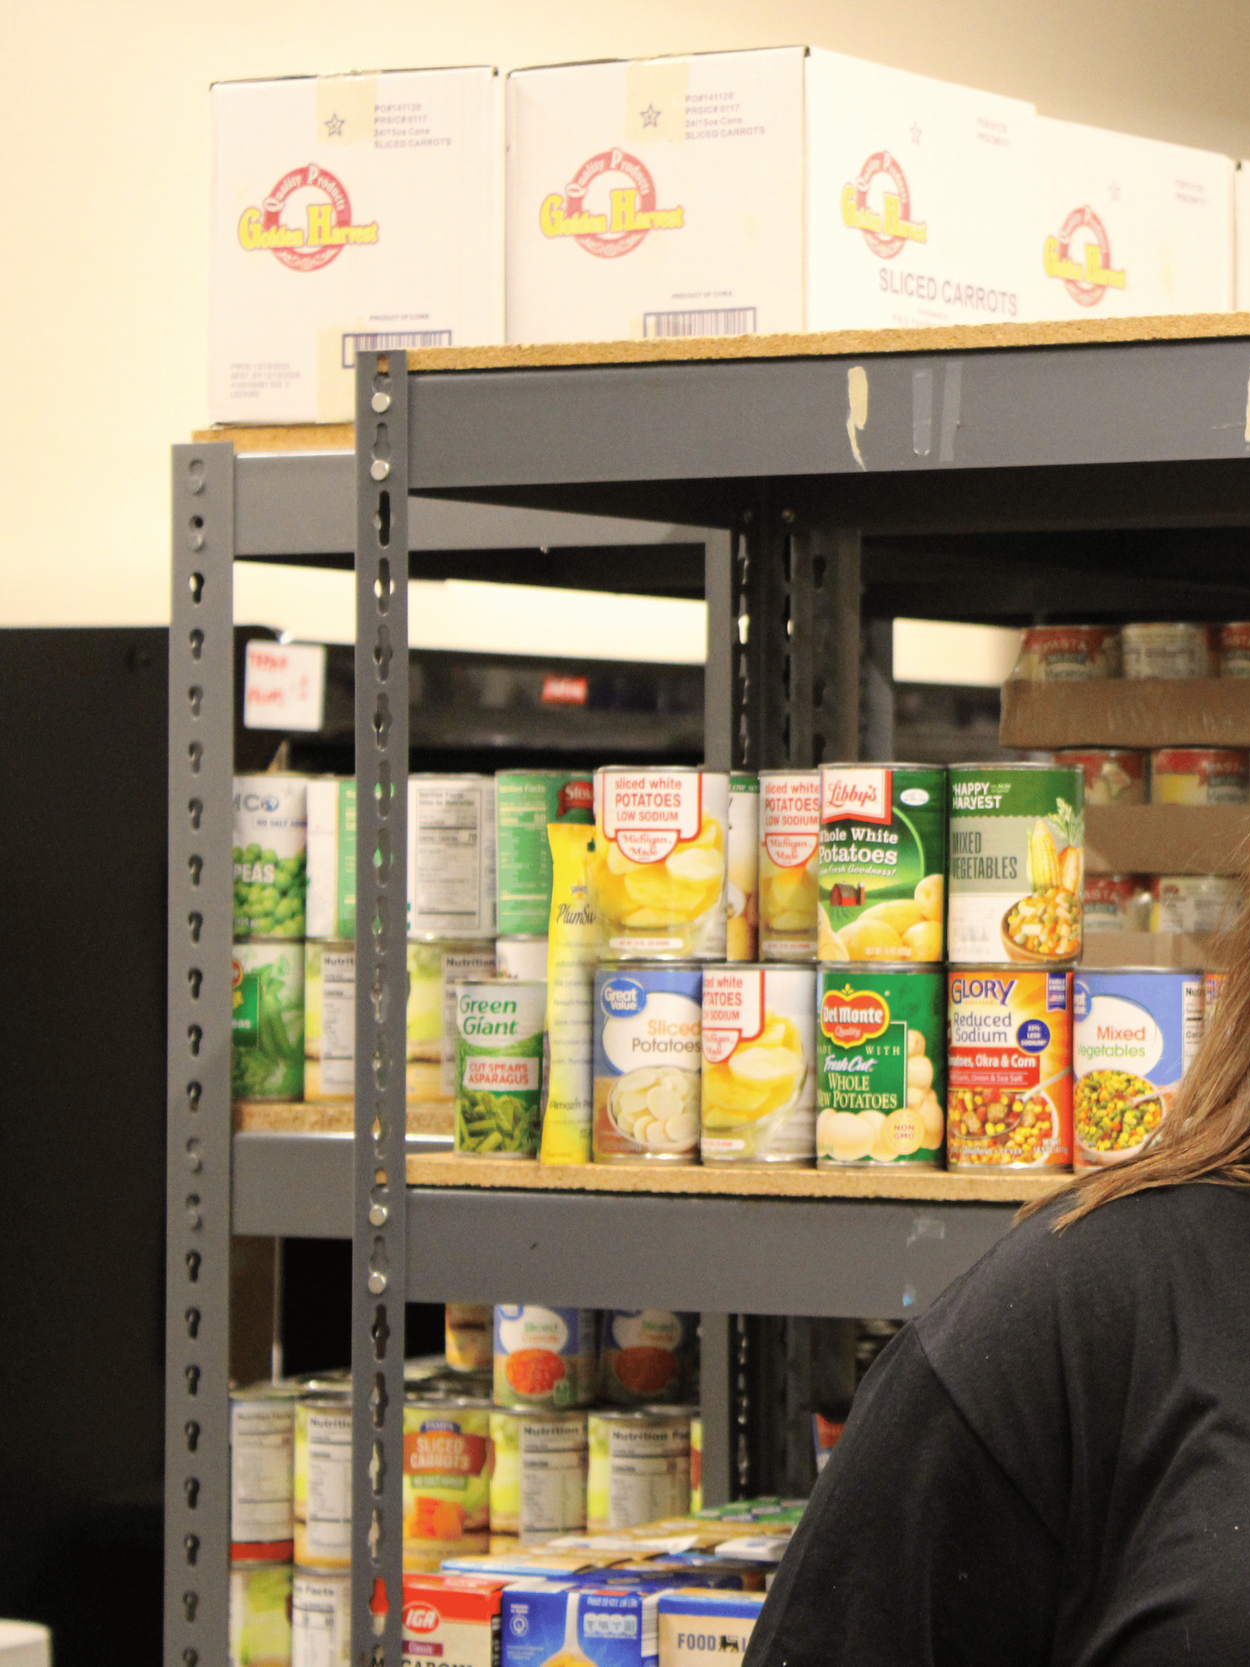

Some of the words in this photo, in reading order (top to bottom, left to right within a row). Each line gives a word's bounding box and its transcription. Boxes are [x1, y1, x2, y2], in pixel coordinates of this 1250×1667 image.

[720, 126, 765, 138] CARROTS
[408, 137, 451, 148] CARROTS
[540, 193, 608, 239] Golden
[609, 187, 685, 232] Harvest
[238, 207, 304, 251] Golden
[306, 203, 379, 247] Harvest
[878, 267, 938, 301] SLICED
[941, 279, 1018, 317] CARROTS
[615, 778, 645, 790] sliced
[649, 778, 682, 790] white
[765, 782, 787, 794] sliced
[790, 782, 820, 794] white
[953, 782, 990, 796] HAPPY
[615, 793, 682, 808] POTATOES
[827, 780, 878, 808] Libby's
[765, 798, 820, 812] POTATOES
[952, 795, 1003, 810] HARVEST
[617, 811, 636, 822] LOW
[638, 811, 678, 822] SODIUM
[766, 815, 779, 826] LOW
[782, 815, 818, 826] SODIUM
[622, 834, 668, 848] Michigan
[850, 827, 898, 845] White
[952, 831, 982, 855] MIXED
[629, 846, 658, 857] Made
[819, 843, 898, 866] Potatoes
[233, 863, 274, 883] PEAS
[952, 856, 1018, 880] VEGETABLES
[324, 957, 354, 966] Nutrit
[716, 977, 743, 989] white
[605, 988, 638, 1002] Great
[703, 992, 742, 1007] TATOES
[952, 979, 1019, 1007] GLORY
[459, 995, 517, 1014] Green
[610, 1000, 637, 1011] Value
[710, 1010, 740, 1021] SODIUM
[823, 1007, 838, 1023] Del
[838, 1007, 883, 1024] Monte
[953, 1012, 1012, 1028] Reduced
[463, 1016, 519, 1036] Giant
[647, 1019, 701, 1036] Sliced
[834, 1026, 862, 1039] Quality
[1097, 1026, 1146, 1041] Mixed
[954, 1028, 1008, 1043] Sodium
[1027, 1031, 1041, 1039] LESS
[632, 1038, 702, 1054] Potatoes
[865, 1045, 901, 1056] WITH
[1078, 1045, 1145, 1060] Vegetables
[469, 1062, 486, 1073] CUT
[488, 1062, 528, 1073] SPEARS
[975, 1053, 999, 1068] Okra
[1001, 1055, 1009, 1068] &
[1011, 1055, 1037, 1068] Corn
[469, 1073, 529, 1085] ASPARAGUS
[828, 1073, 870, 1091] WHOLE
[833, 1090, 898, 1109] POTATOES
[311, 1418, 352, 1428] Nutritio
[416, 1435, 464, 1454] SLICED
[405, 1608, 436, 1629] IGA
[677, 1632, 716, 1652] FOOD
